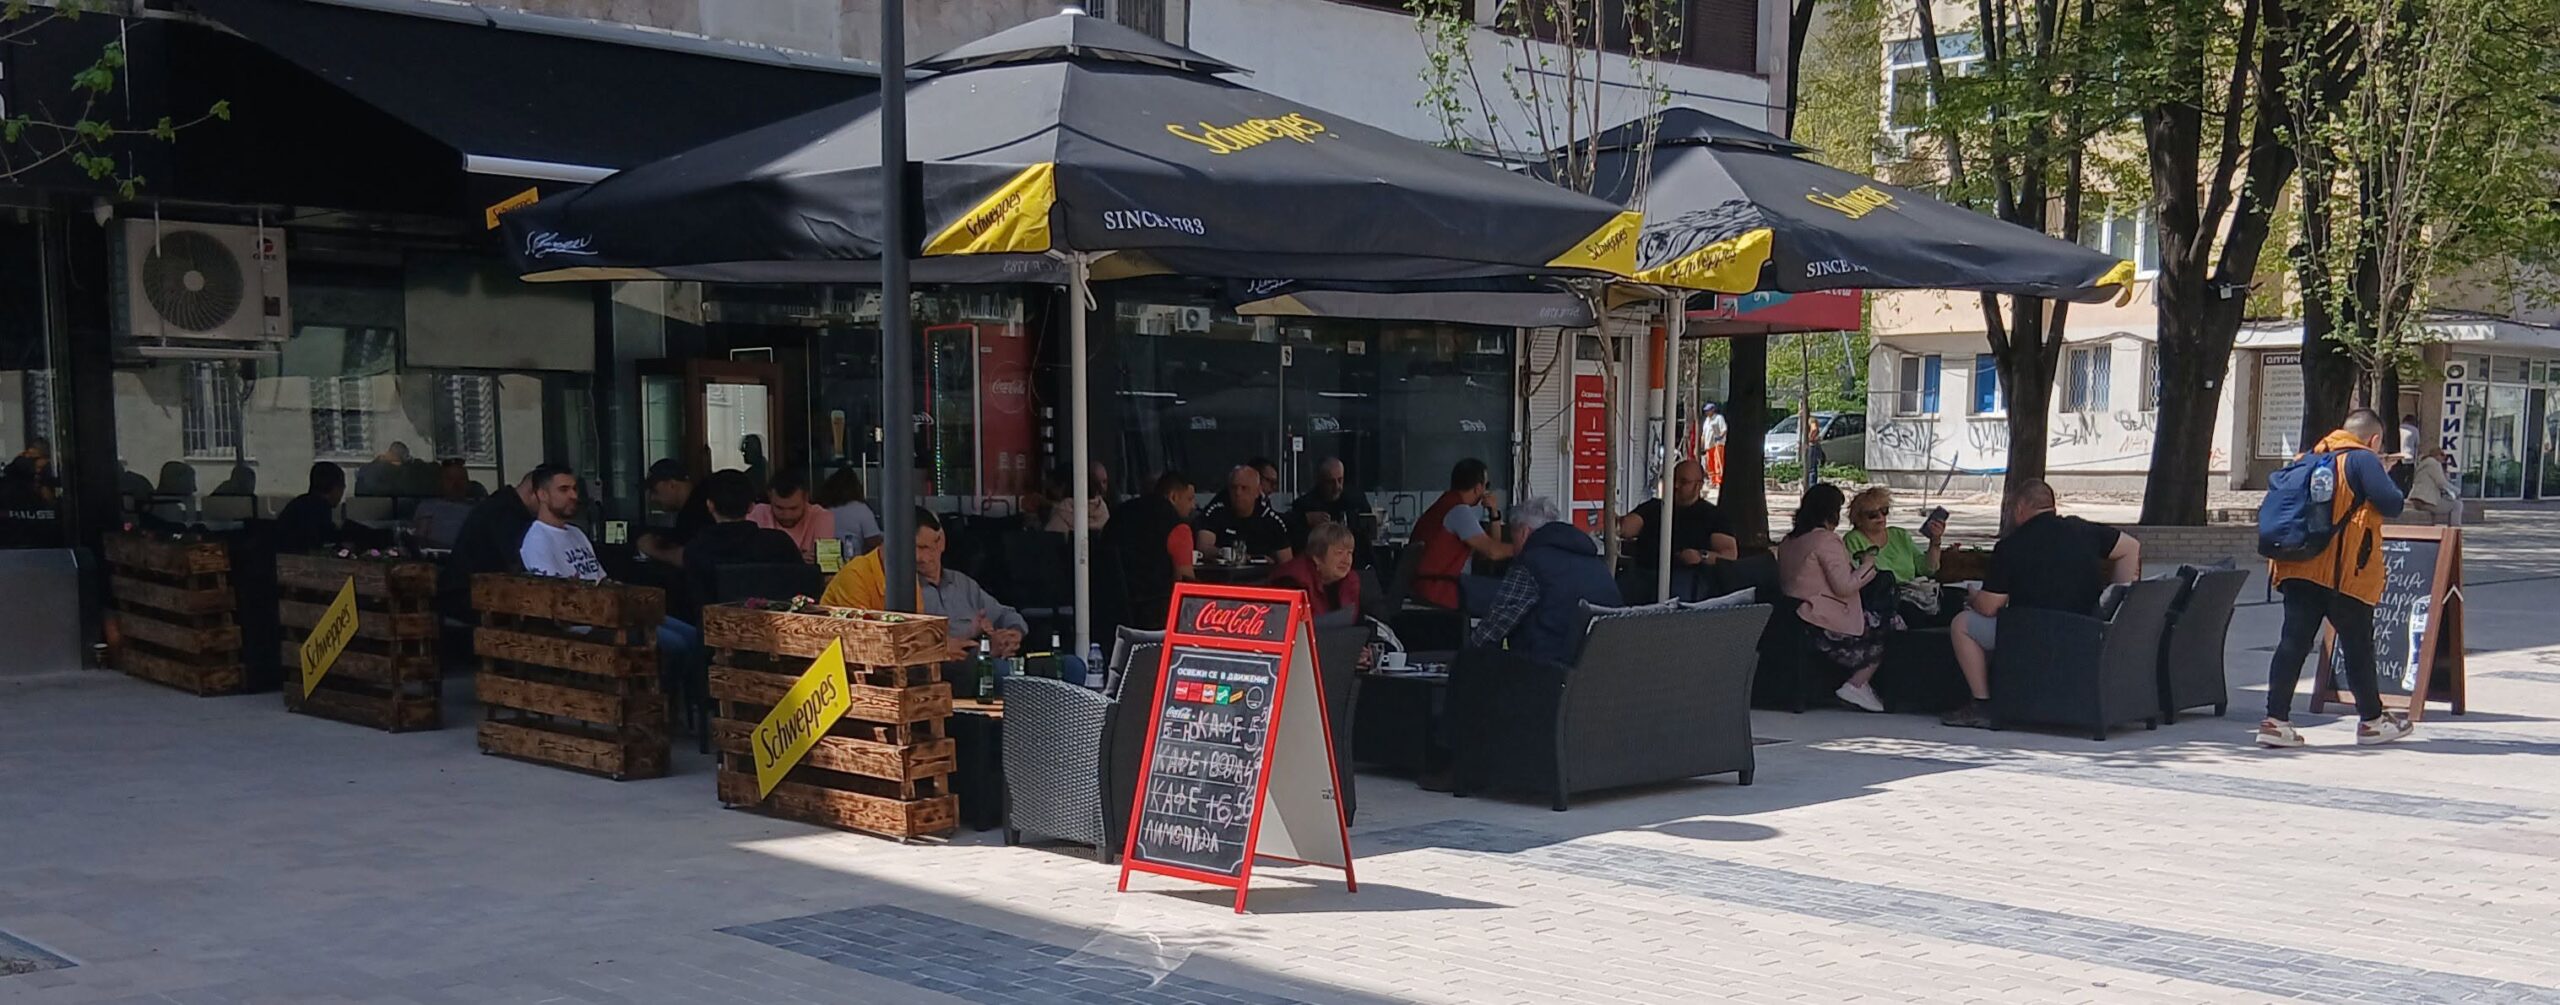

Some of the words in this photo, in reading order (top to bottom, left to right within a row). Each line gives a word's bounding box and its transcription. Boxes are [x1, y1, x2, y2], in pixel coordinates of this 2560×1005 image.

[1166, 112, 1326, 154] Schweppes
[966, 190, 1021, 238] Schweppes
[1103, 210, 1169, 230] SINCE
[1586, 227, 1628, 261] Schweppes
[1806, 259, 1851, 278] SINCE
[1195, 600, 1271, 636] Coca-Cola
[306, 603, 351, 676] Schweppes
[1227, 673, 1270, 685] ДВИЖЕНИЕ
[760, 674, 837, 768] Schweppes
[1150, 777, 1202, 815] КАФЕ
